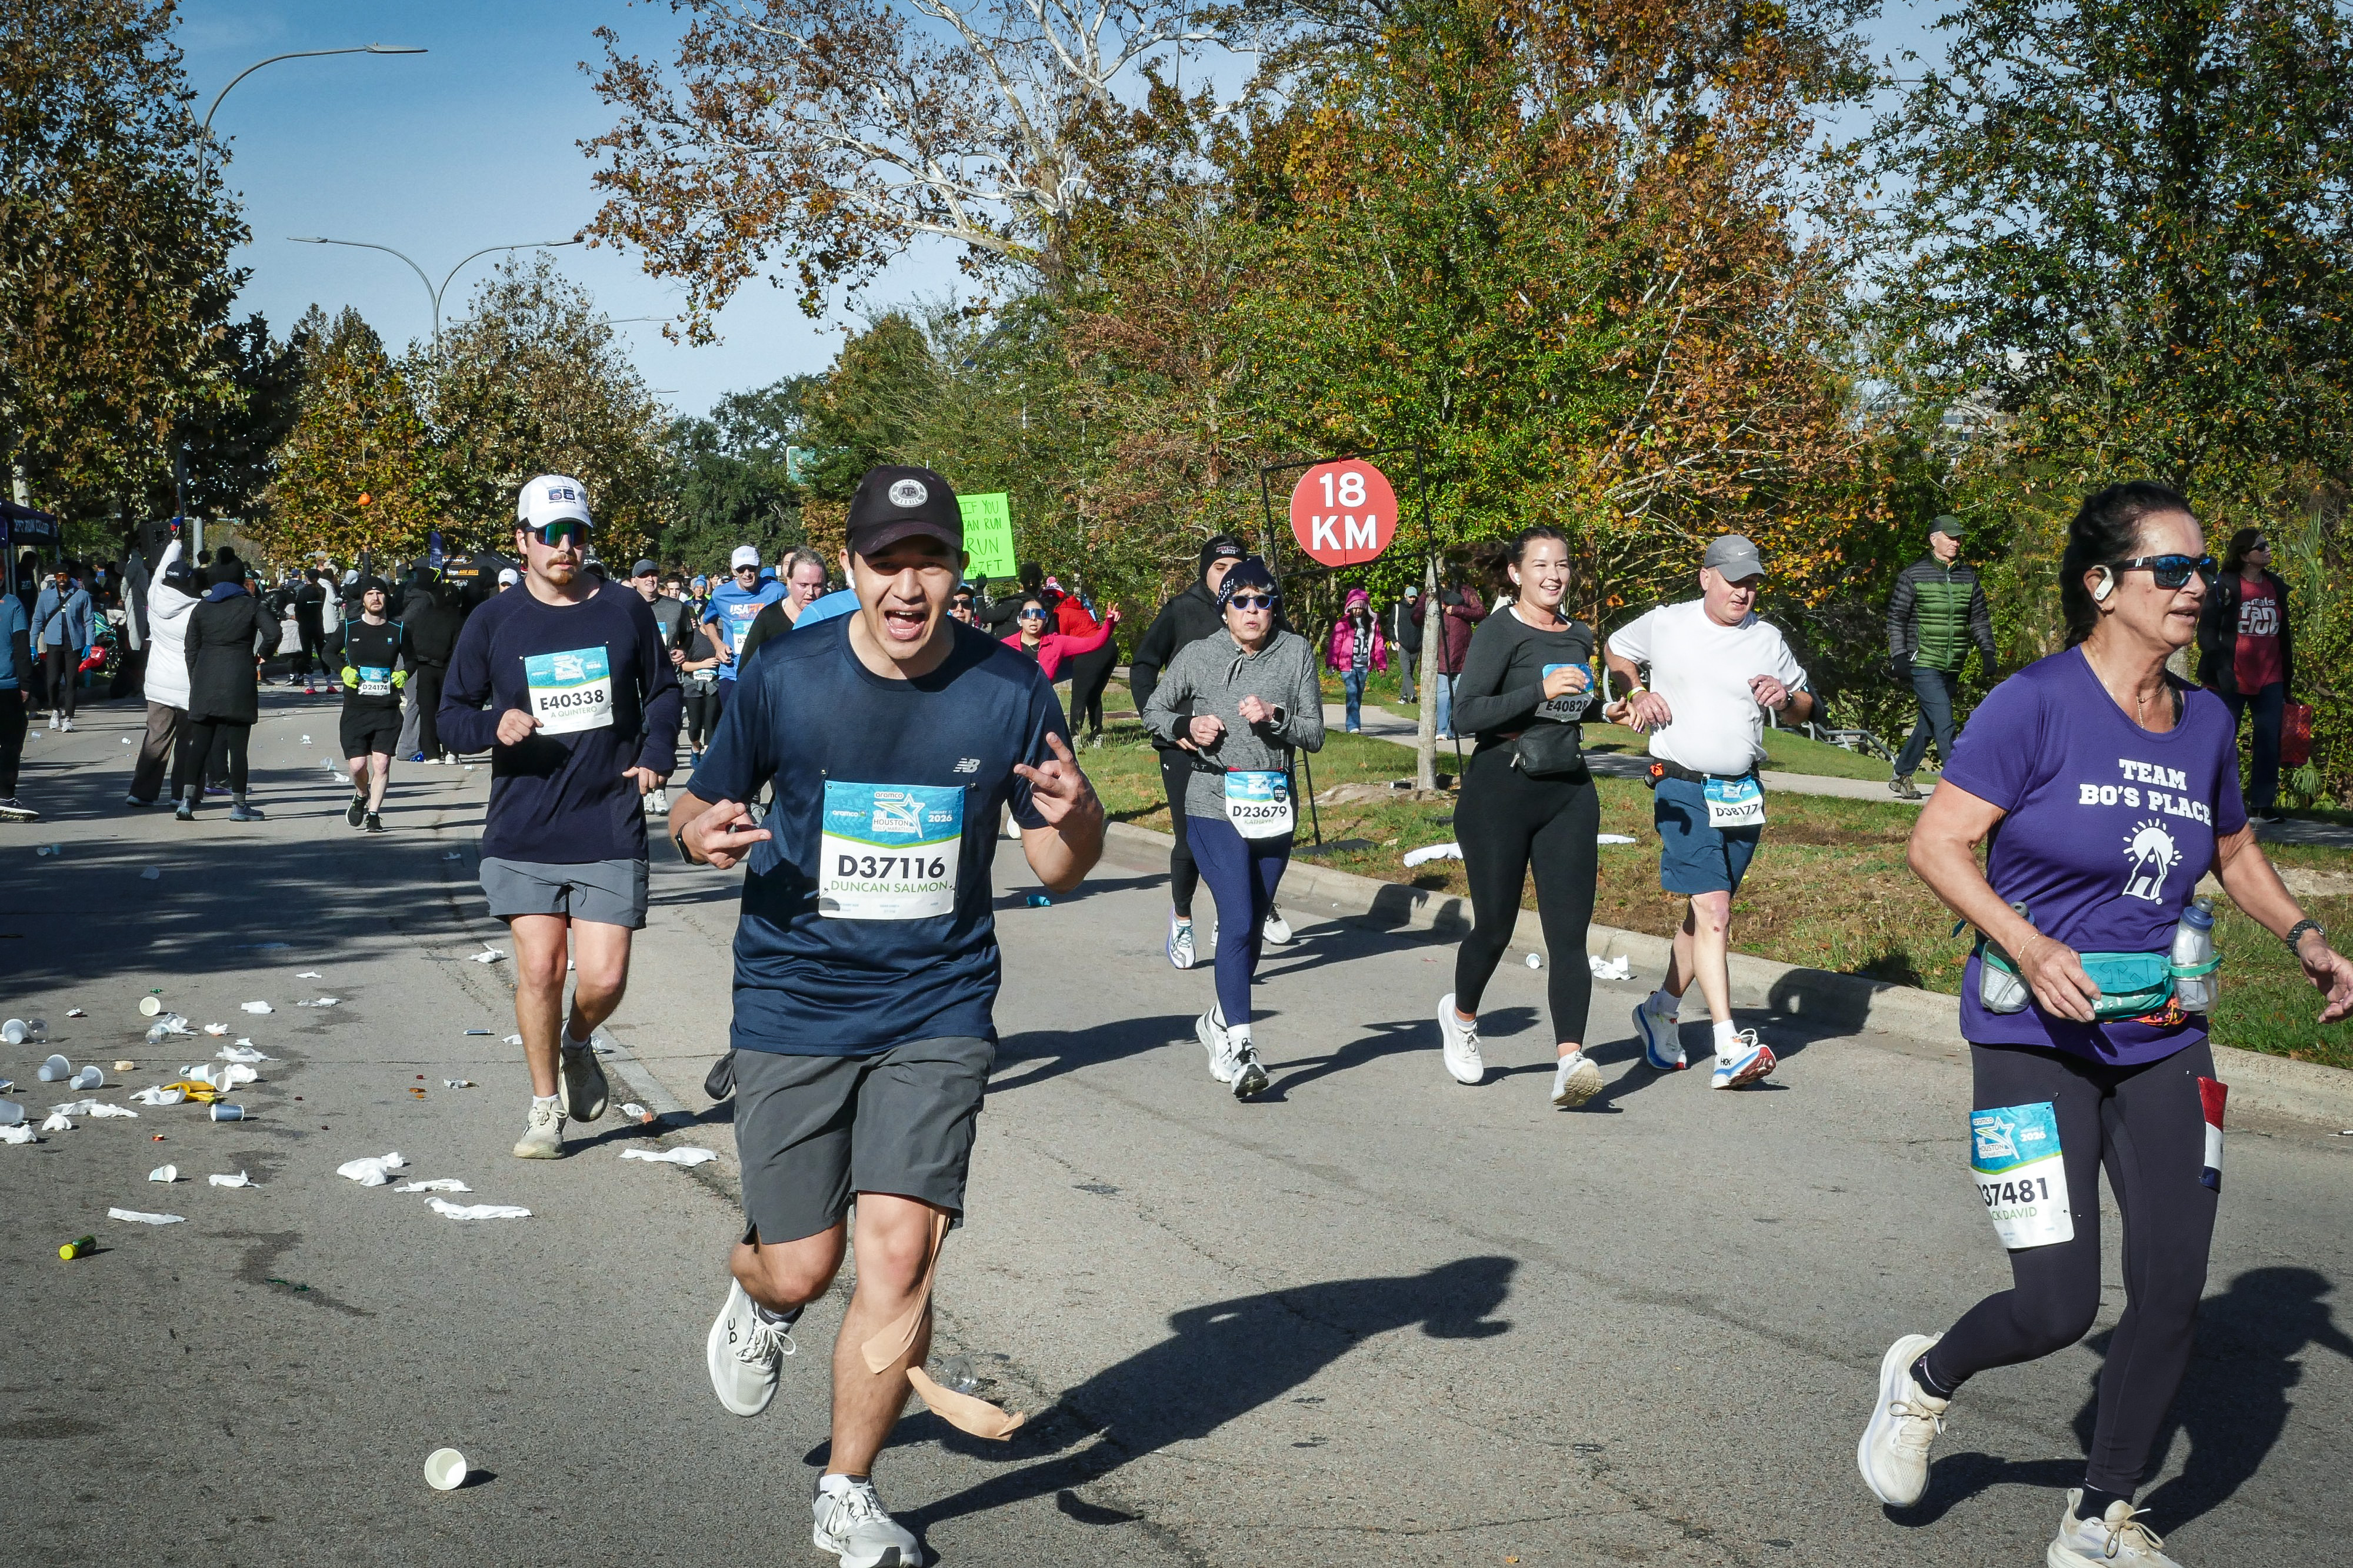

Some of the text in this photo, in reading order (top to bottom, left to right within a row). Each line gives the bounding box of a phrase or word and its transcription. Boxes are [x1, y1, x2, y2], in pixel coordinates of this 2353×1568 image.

[1319, 472, 1367, 508] 18
[959, 499, 999, 515] IF YOU
[984, 518, 1002, 530] RUN
[1312, 515, 1377, 550] KM
[966, 536, 999, 556] RUN
[968, 559, 1002, 575] #ZFT
[2240, 601, 2277, 620] fan
[2237, 619, 2279, 635] club
[540, 689, 604, 710] E40338
[558, 706, 598, 717] QUINTERO
[2118, 758, 2187, 791] TEAM
[1232, 806, 1287, 818] D23679
[1715, 803, 1759, 817] D38177
[2079, 783, 2211, 827] BO'S PLACE
[928, 814, 953, 822] 2026
[838, 855, 945, 879] D37116
[831, 880, 948, 893] DUNCAN SALMON
[2021, 1132, 2046, 1142] 2026
[2003, 1206, 2038, 1220] DAVID
